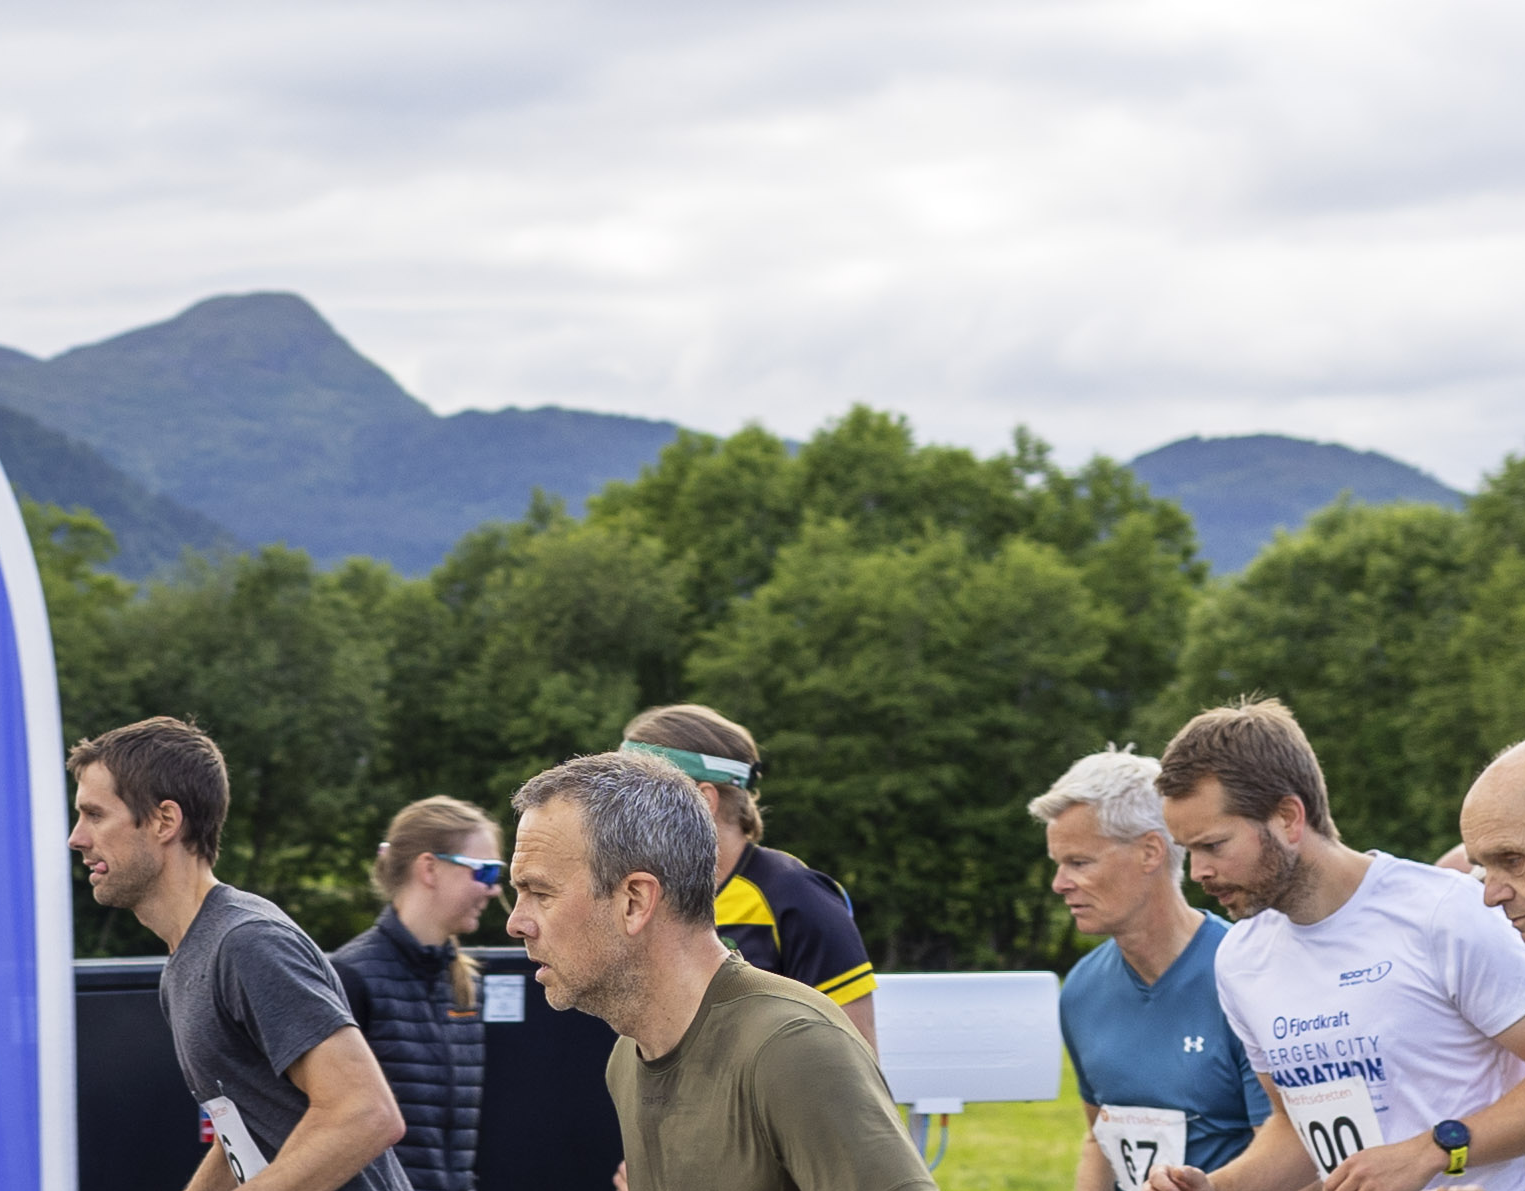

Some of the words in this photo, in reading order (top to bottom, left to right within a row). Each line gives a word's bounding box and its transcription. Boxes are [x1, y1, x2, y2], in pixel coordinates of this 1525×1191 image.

[1290, 1011, 1350, 1037] Fjordkraft
[1269, 1042, 1329, 1066] ERGEN
[1335, 1035, 1379, 1057] CITY
[1121, 1139, 1158, 1185] 67
